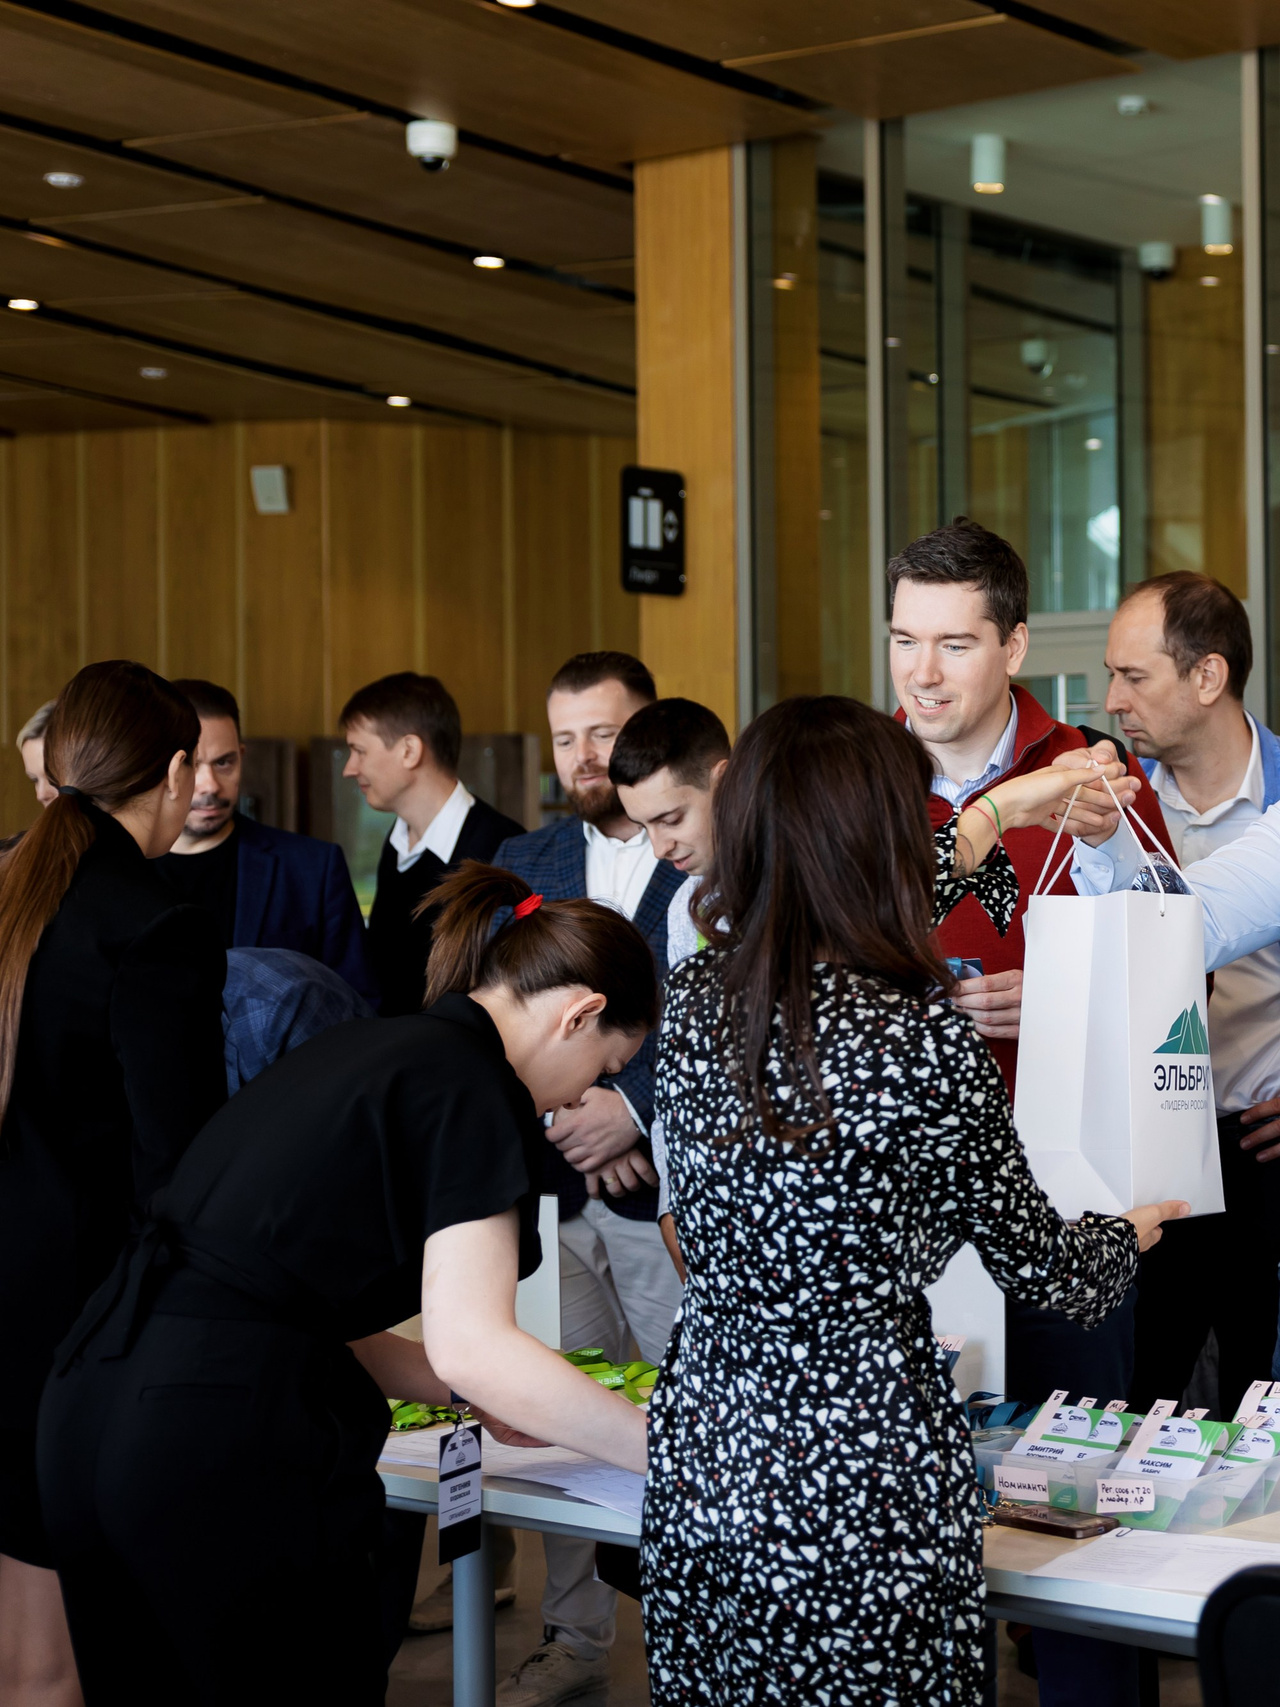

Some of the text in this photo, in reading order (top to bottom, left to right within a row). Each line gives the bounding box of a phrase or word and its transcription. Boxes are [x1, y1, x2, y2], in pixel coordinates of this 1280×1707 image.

[1027, 1444, 1065, 1456] ДМИТРИЙ
[1139, 1459, 1173, 1469] МАКСИМ
[998, 1476, 1048, 1494] Номинанты
